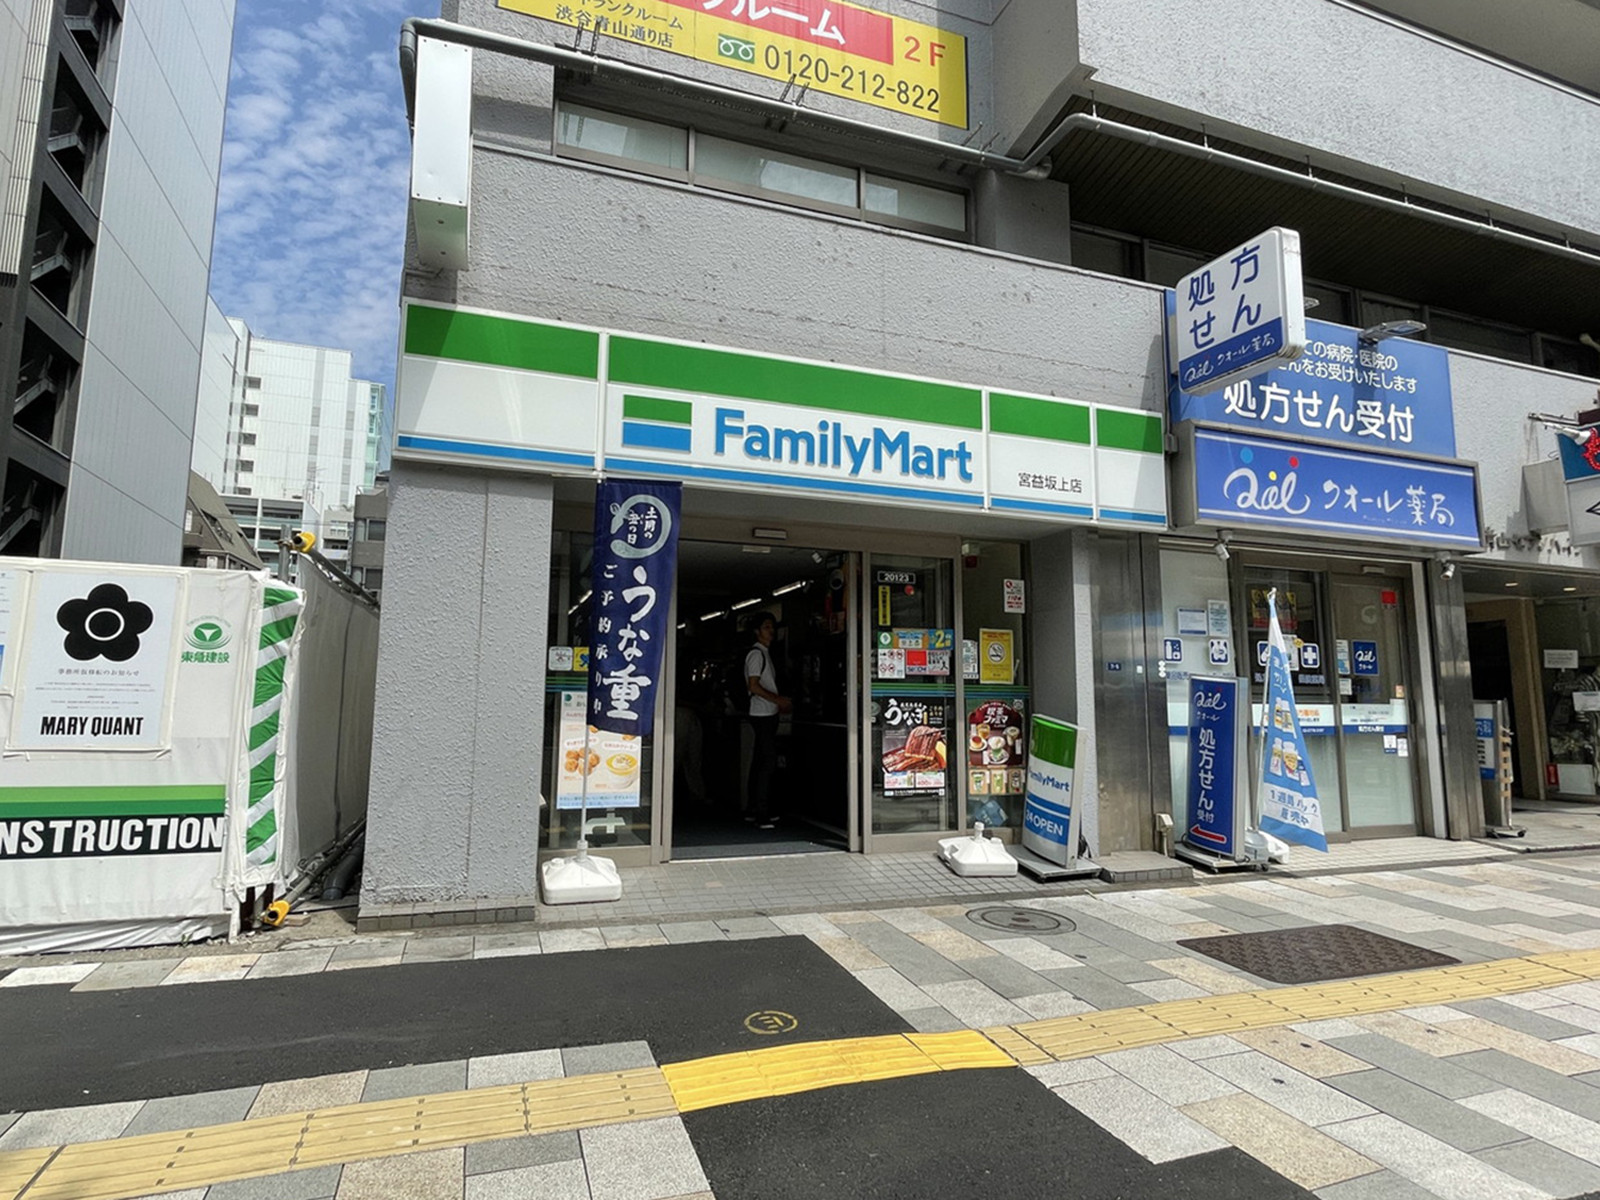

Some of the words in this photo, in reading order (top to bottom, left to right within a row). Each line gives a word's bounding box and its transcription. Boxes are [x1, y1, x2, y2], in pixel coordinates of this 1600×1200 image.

[555, 4, 674, 48] 渋谷青山通り店
[904, 36, 946, 67] 2F
[765, 44, 940, 113] 0120-212-822
[1217, 333, 1275, 365] クオール薬局
[1278, 358, 1418, 394] んをお受けいたします
[1223, 379, 1415, 443] 処方せん受付
[714, 407, 973, 483] FamilyMart
[1018, 472, 1082, 493] 宮益坂上店
[1322, 479, 1455, 527] クオール薬局
[644, 506, 658, 539] 土用の
[884, 573, 909, 582] 20123
[593, 564, 618, 714] ご予約承り中
[602, 565, 657, 720] うな重
[40, 716, 88, 735] MARY
[91, 717, 144, 737] QUANT
[884, 698, 927, 726] うなぎ
[1198, 727, 1216, 810] 処方せん
[0, 817, 224, 855] NSTRUCTION
